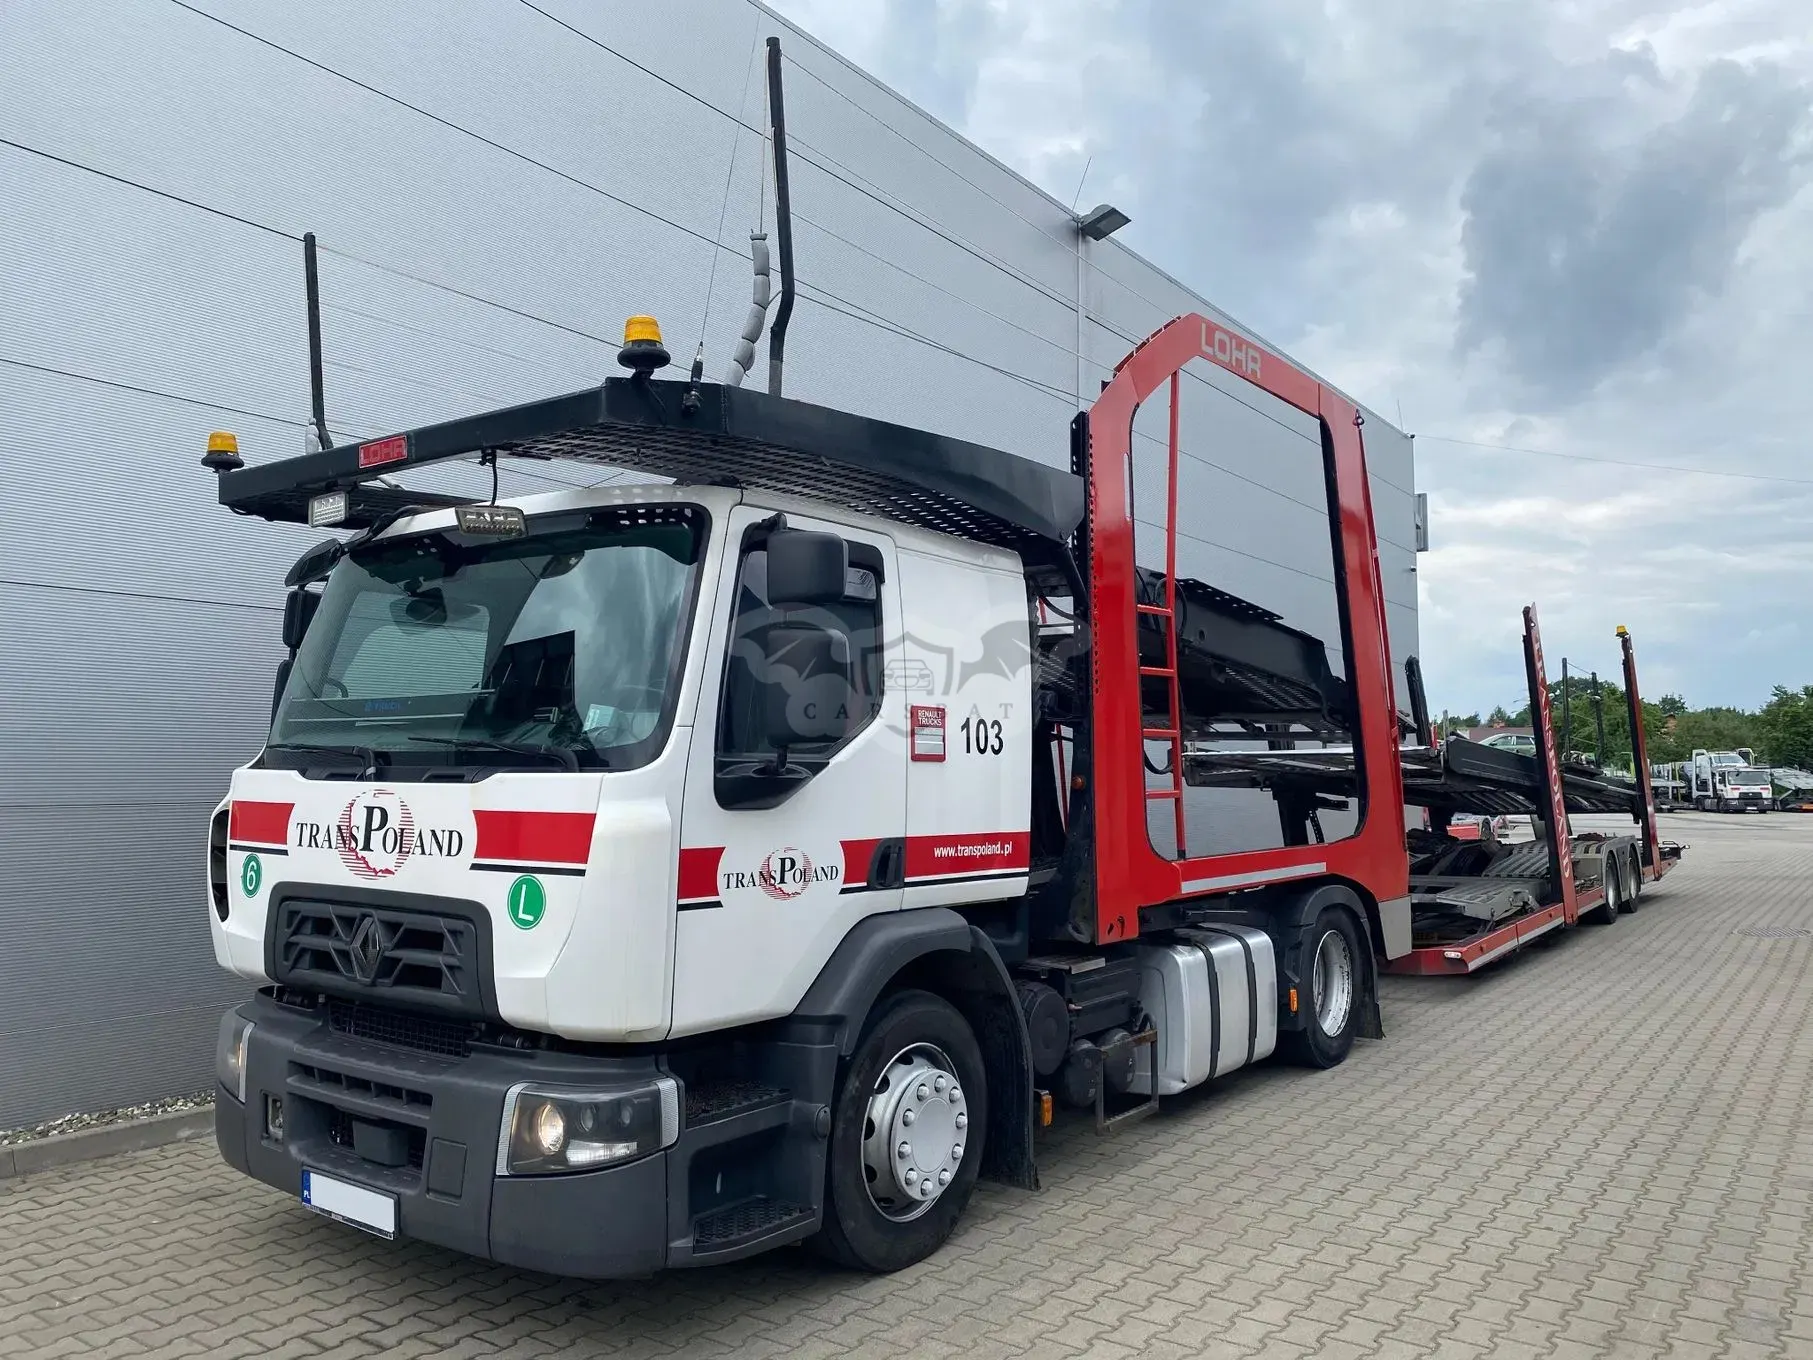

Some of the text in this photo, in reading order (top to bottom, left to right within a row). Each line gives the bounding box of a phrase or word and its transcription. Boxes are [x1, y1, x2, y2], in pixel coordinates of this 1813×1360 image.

[1201, 321, 1261, 380] LOHR
[361, 439, 406, 466] LOHR
[918, 709, 943, 719] RENAULT
[918, 717, 943, 726] TRUCKS
[960, 717, 1004, 756] 103
[296, 804, 464, 859] TRANSPOLAND
[933, 840, 1013, 859] www.transpoland.pl
[245, 862, 257, 890] 6
[723, 855, 840, 891] TRANSPOLAND
[518, 886, 535, 922] L
[303, 1190, 311, 1199] PL
